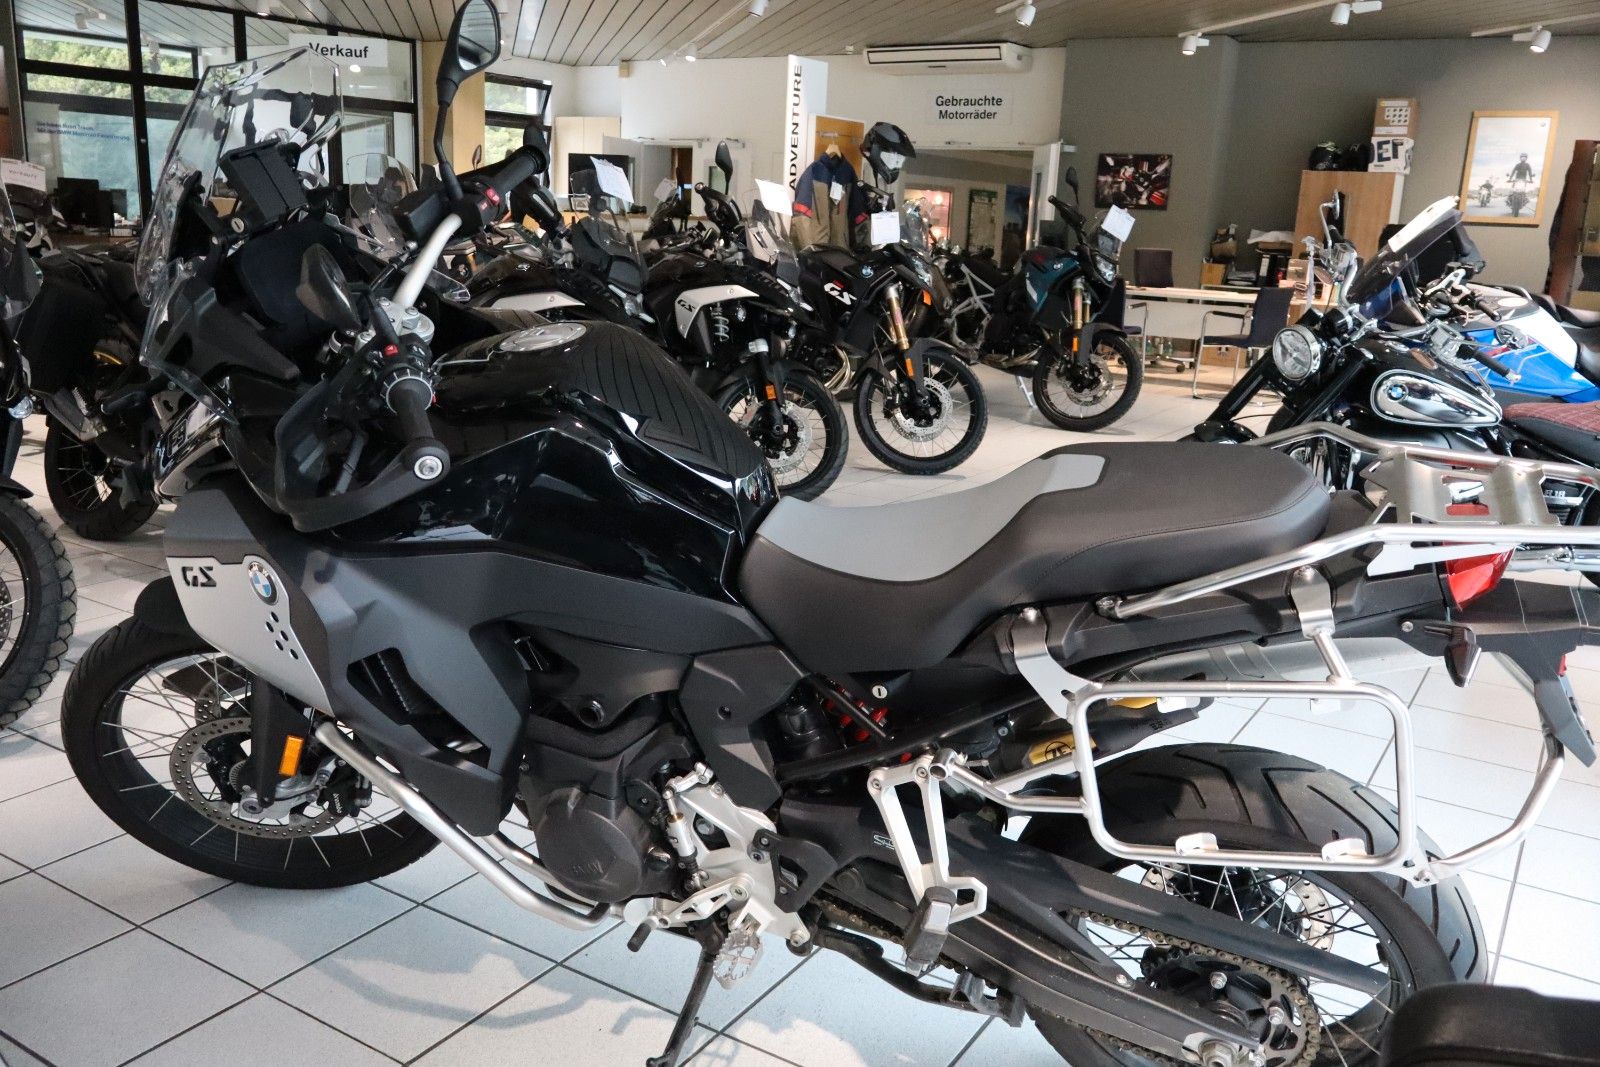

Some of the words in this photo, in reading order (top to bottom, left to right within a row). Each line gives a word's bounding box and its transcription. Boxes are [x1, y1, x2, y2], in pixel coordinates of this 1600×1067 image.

[309, 42, 369, 59] Verkauf
[935, 95, 1003, 107] Gebrauchte
[938, 109, 998, 120] Motorräder
[788, 64, 802, 191] ADVENTURE
[824, 282, 857, 306] GS
[677, 299, 696, 314] GS
[181, 566, 217, 588] GS
